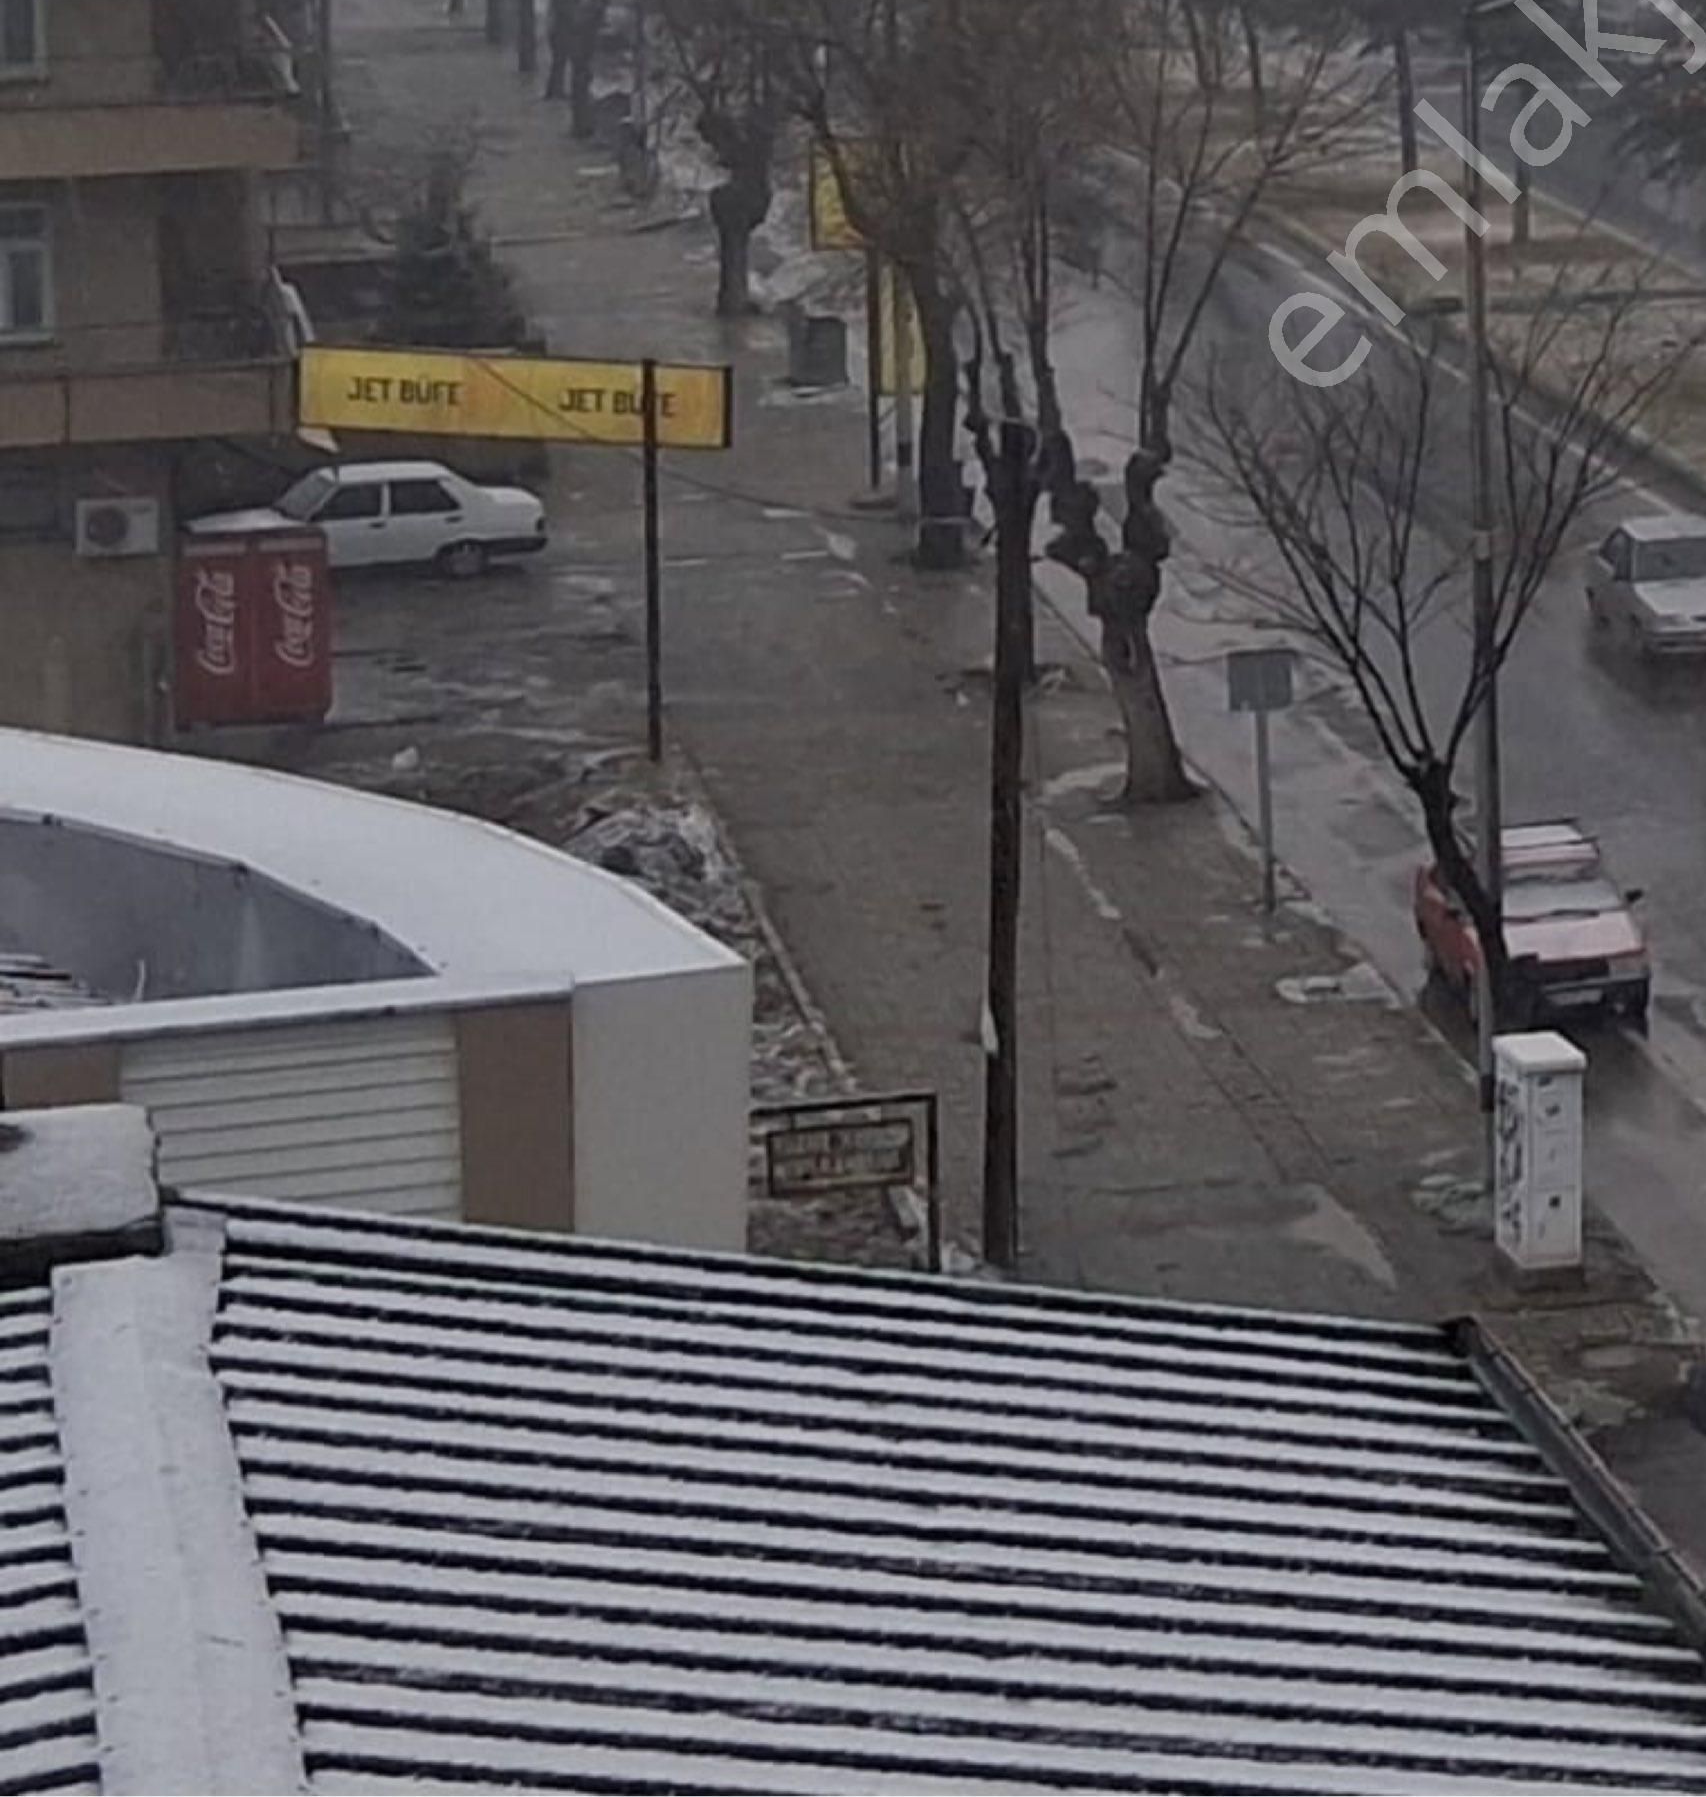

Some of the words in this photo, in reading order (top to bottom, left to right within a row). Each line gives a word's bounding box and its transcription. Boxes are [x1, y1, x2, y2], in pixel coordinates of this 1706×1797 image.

[348, 376, 392, 402] JET
[401, 375, 462, 405] BÜFE
[559, 387, 606, 413] JET
